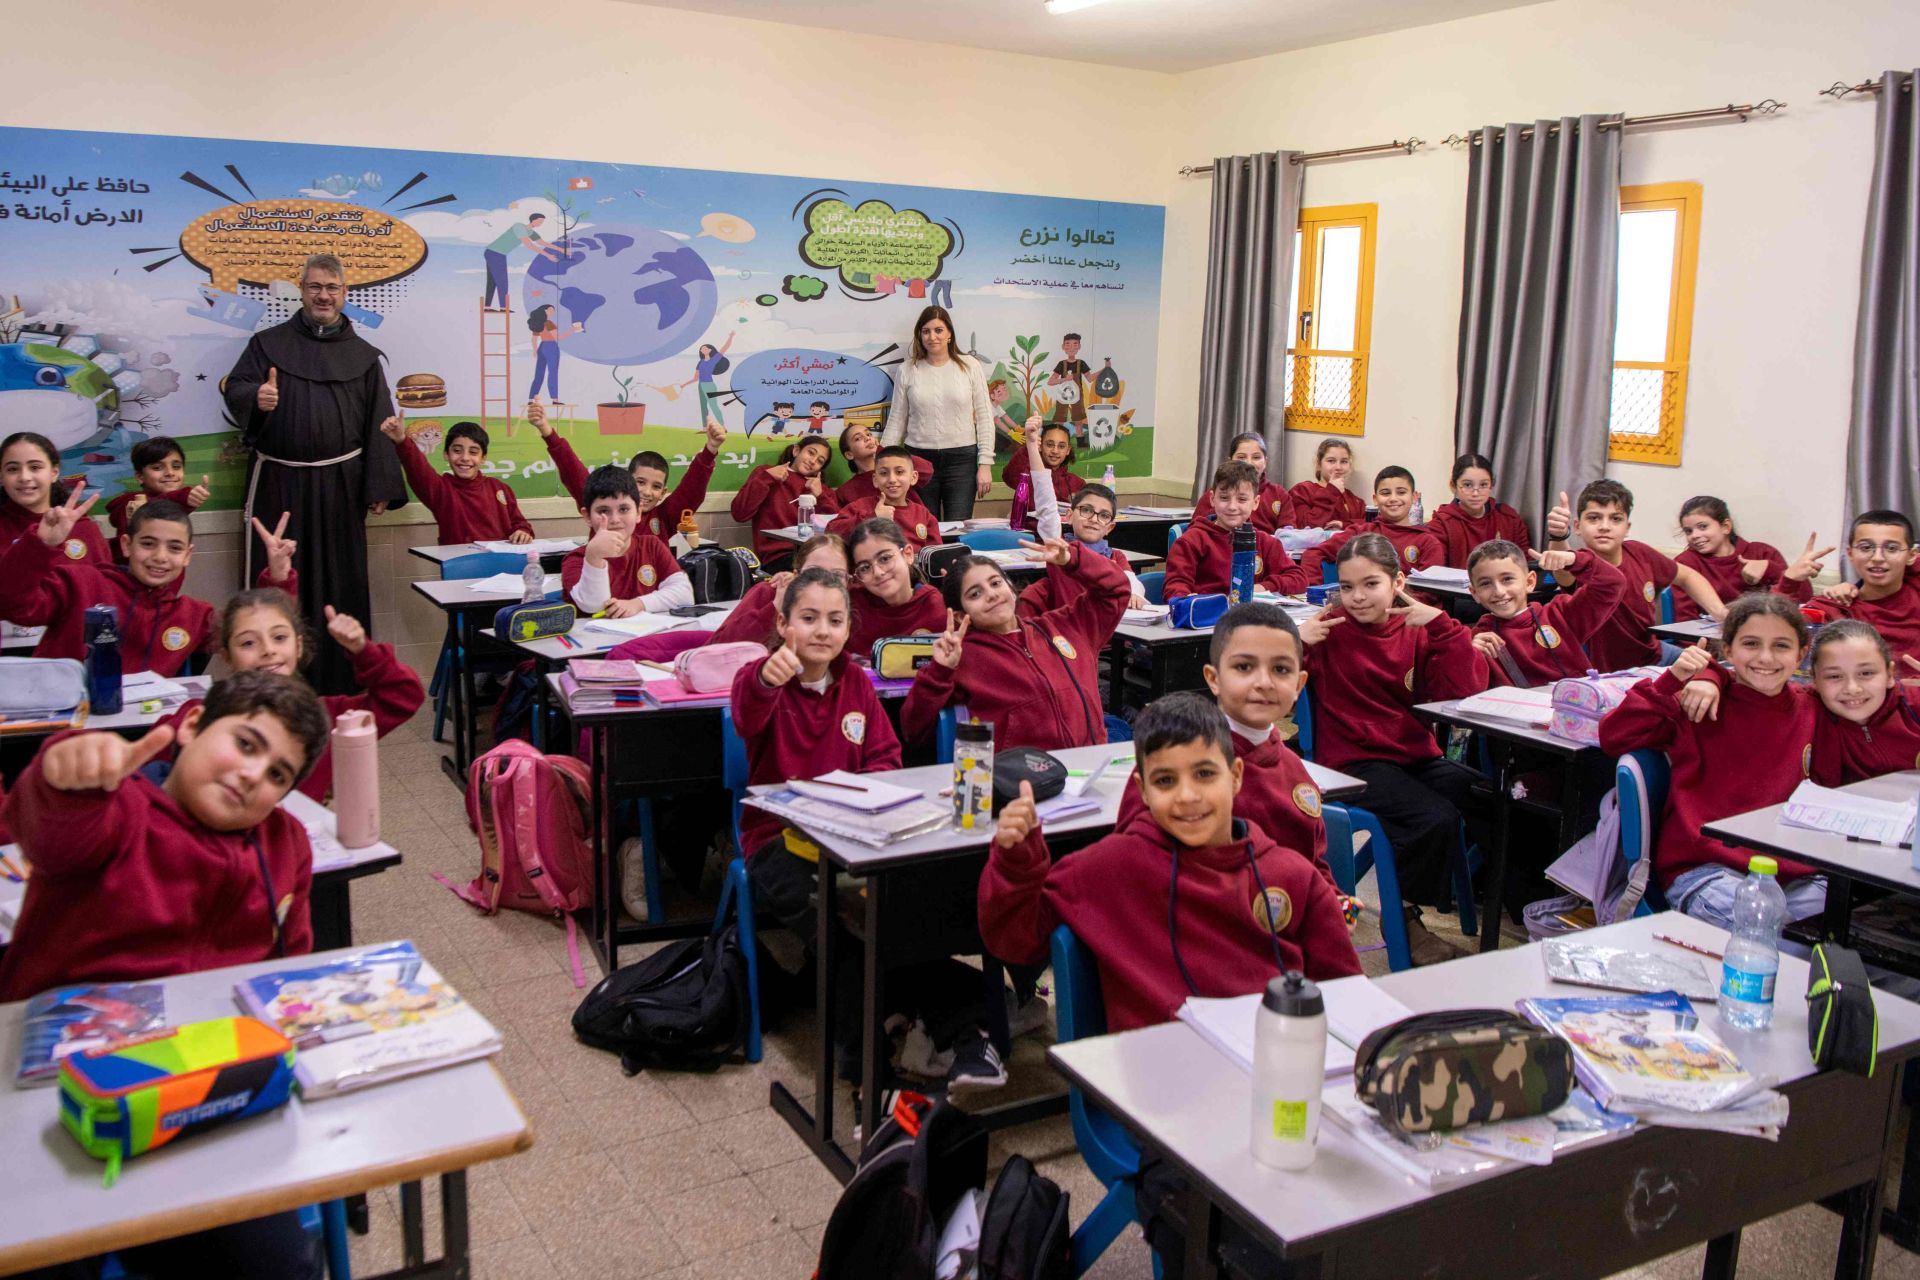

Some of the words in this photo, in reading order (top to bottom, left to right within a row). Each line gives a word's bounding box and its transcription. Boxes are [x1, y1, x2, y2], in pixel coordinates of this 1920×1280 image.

[0, 171, 46, 194] البيئ
[52, 176, 90, 197] على
[95, 177, 150, 193] حافظ
[15, 199, 72, 223] أمانة
[75, 208, 143, 227] الارض
[238, 206, 314, 220] لاستعمال
[205, 218, 286, 233] الاستعمال
[288, 221, 347, 236] متعددة
[348, 218, 393, 237] أدوات
[1019, 226, 1060, 247] نزرع
[1066, 227, 1115, 248] تعالوا
[1048, 256, 1077, 266] عالمنا
[1078, 257, 1121, 271] ولنجعل
[1042, 279, 1069, 289] عملية
[1070, 280, 1080, 290] في
[1095, 282, 1125, 290] لنساهم
